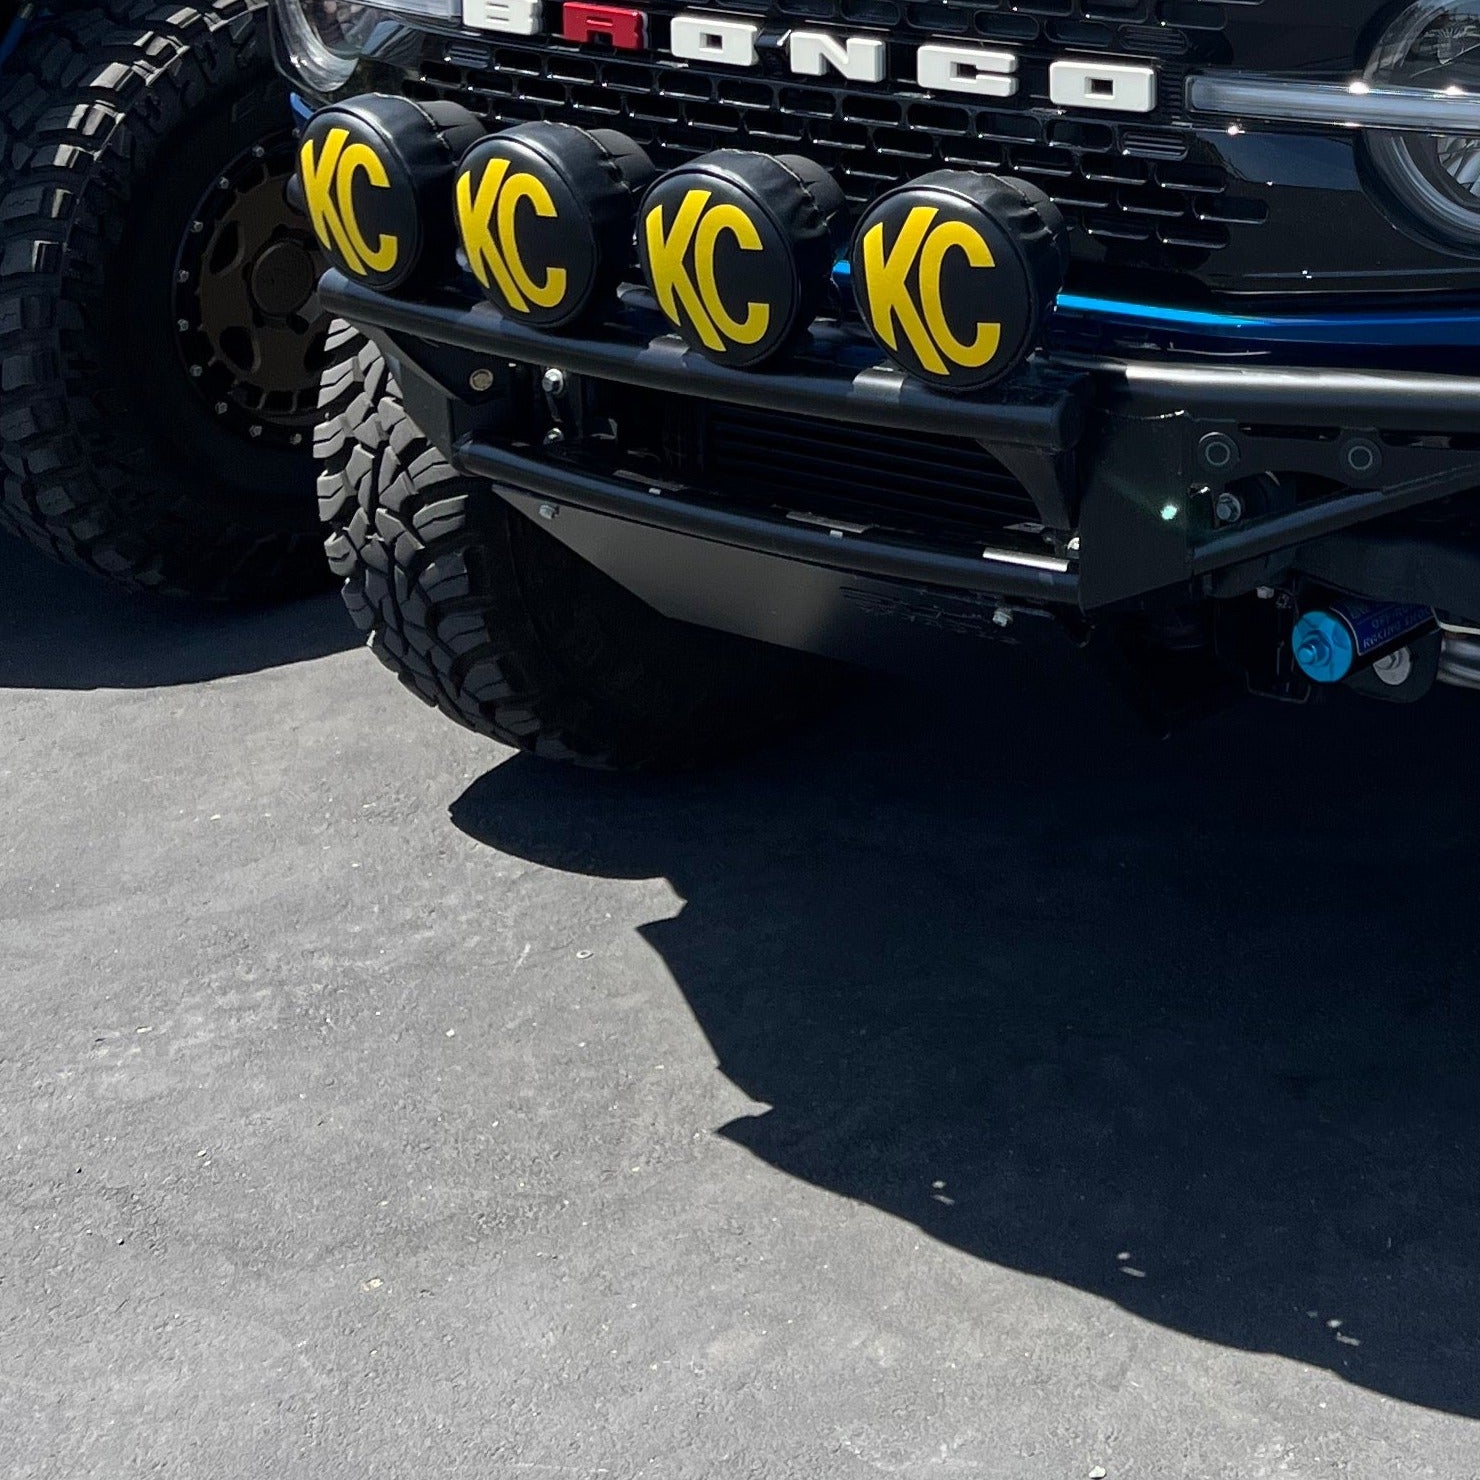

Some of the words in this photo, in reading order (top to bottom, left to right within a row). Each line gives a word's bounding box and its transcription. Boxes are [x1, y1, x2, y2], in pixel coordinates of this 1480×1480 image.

[300, 127, 397, 274] KC
[456, 158, 566, 313] KC
[645, 189, 769, 352] KC
[863, 206, 1001, 375] KC
